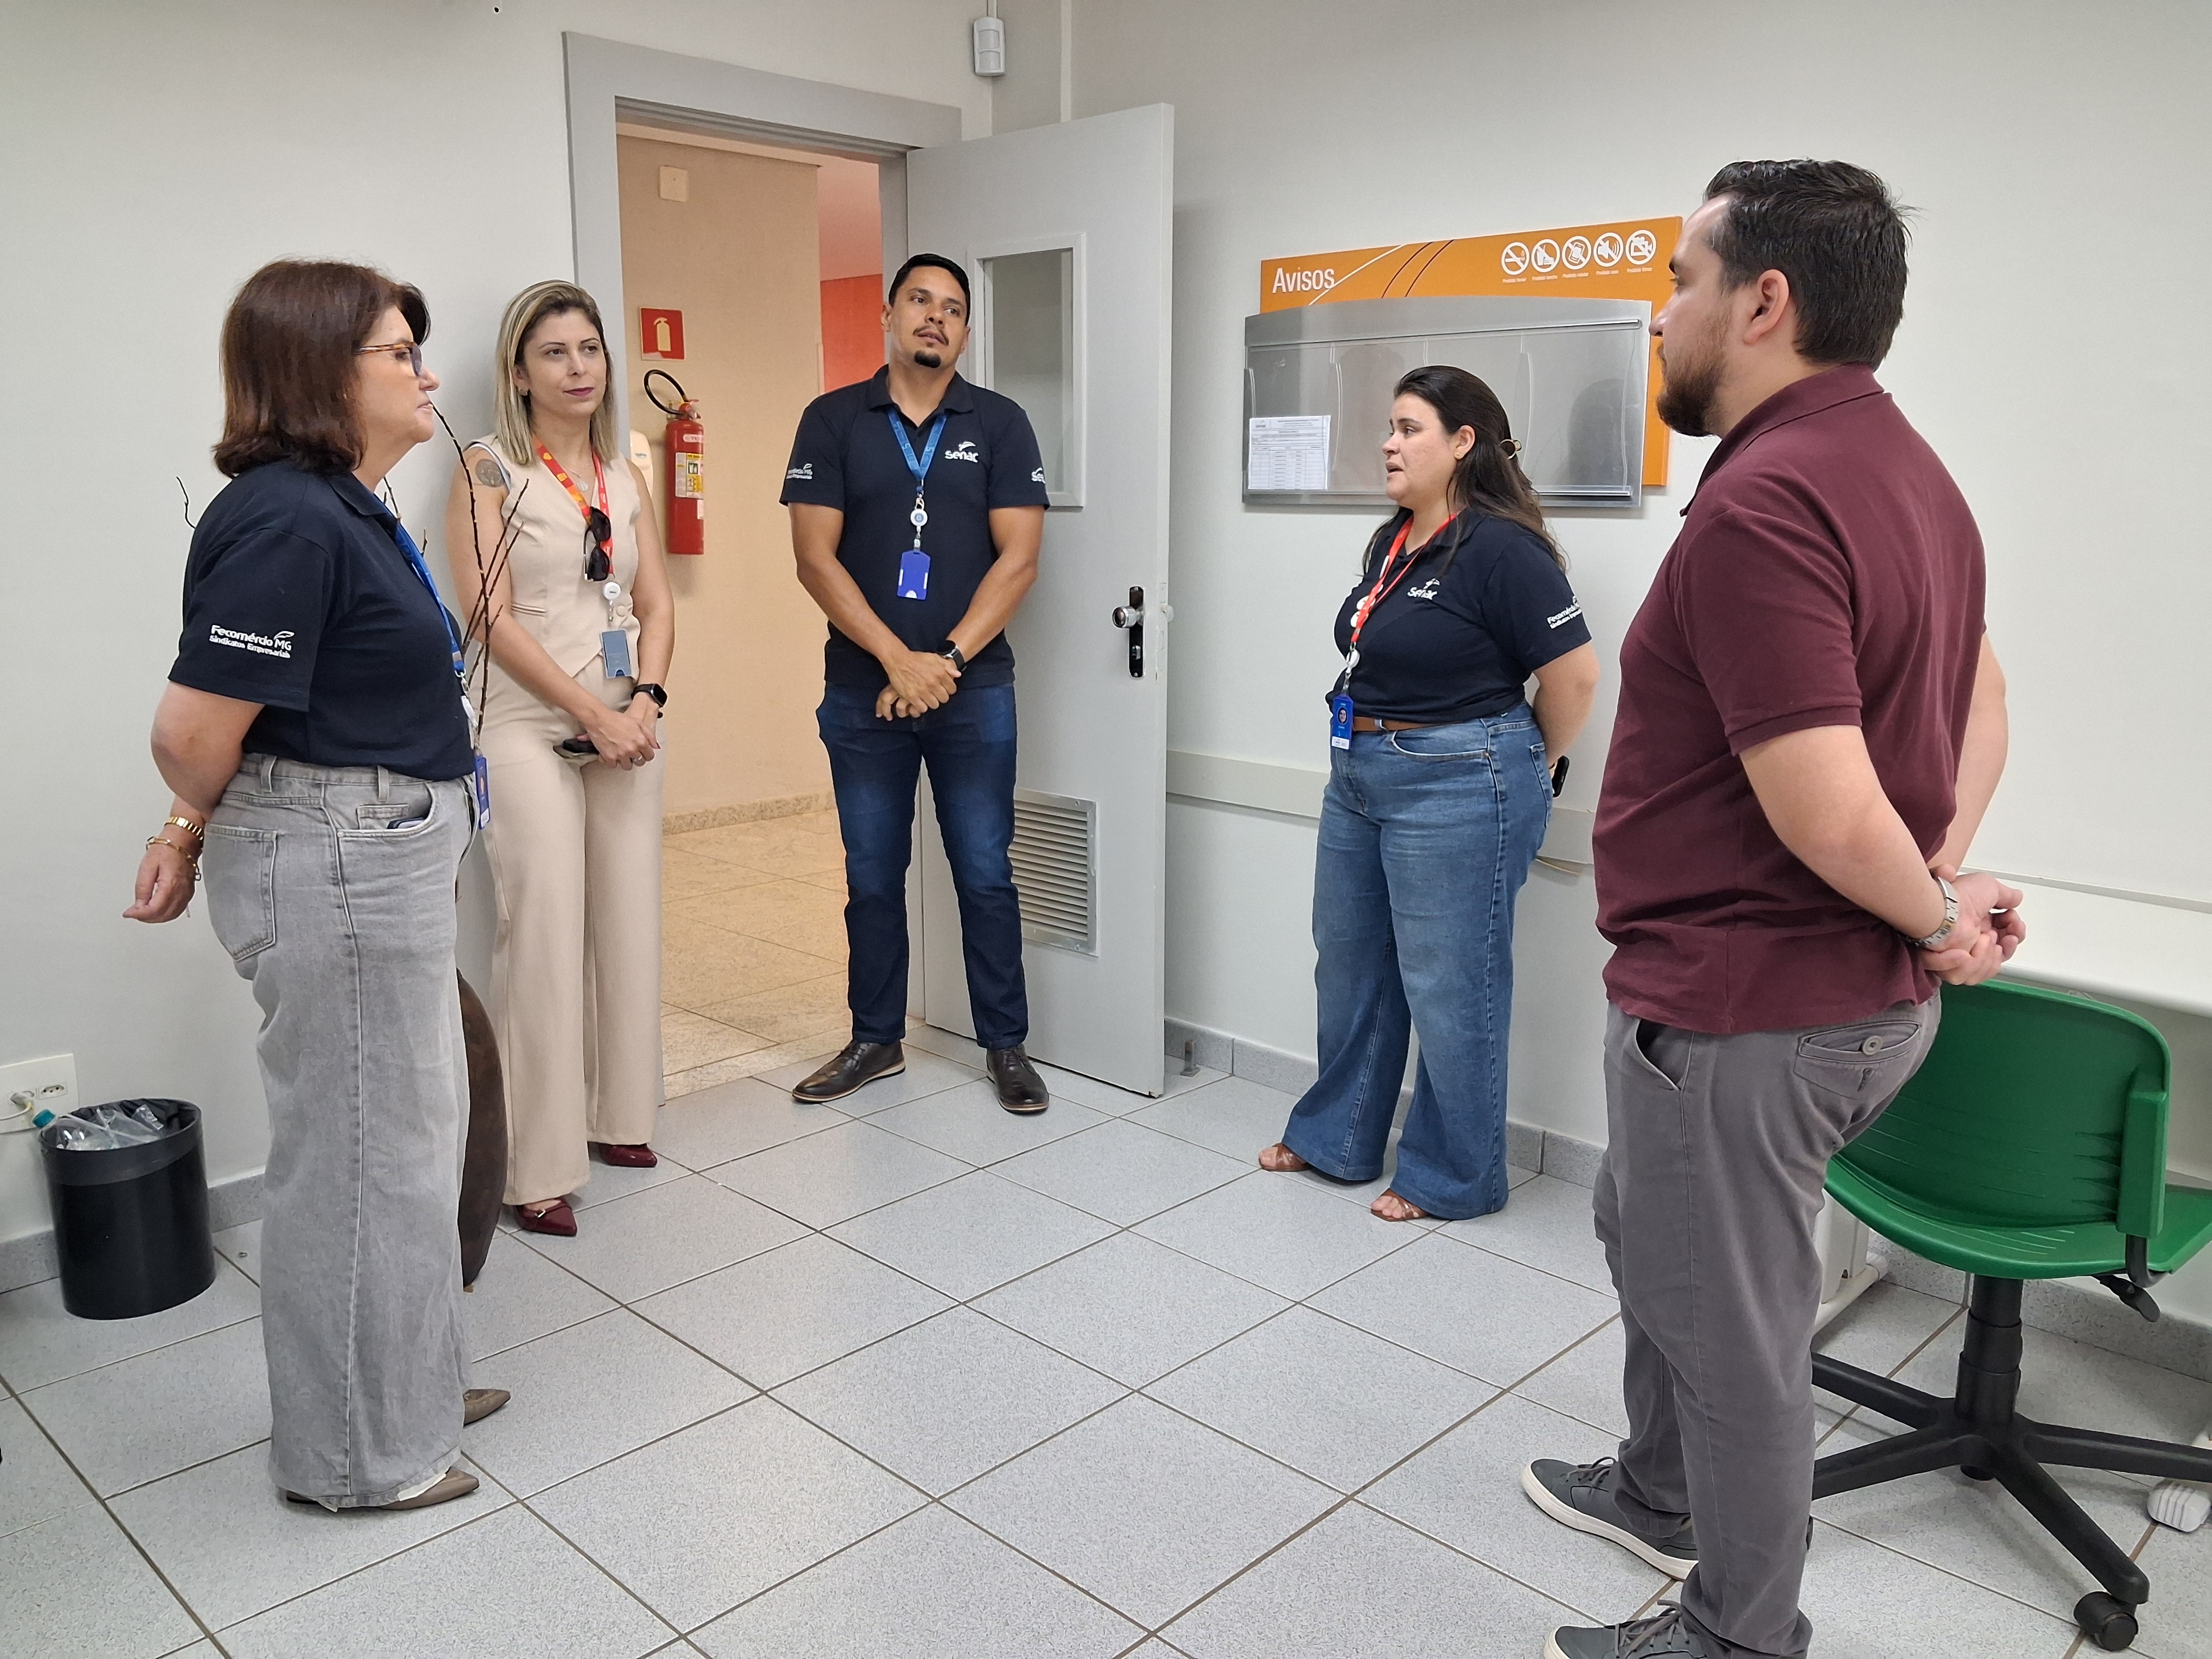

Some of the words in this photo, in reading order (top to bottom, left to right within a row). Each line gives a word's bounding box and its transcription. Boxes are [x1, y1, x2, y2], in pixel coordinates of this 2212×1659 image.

[1272, 267, 1335, 293] Avisos
[211, 625, 273, 646] Fecomércio
[274, 639, 292, 651] MG
